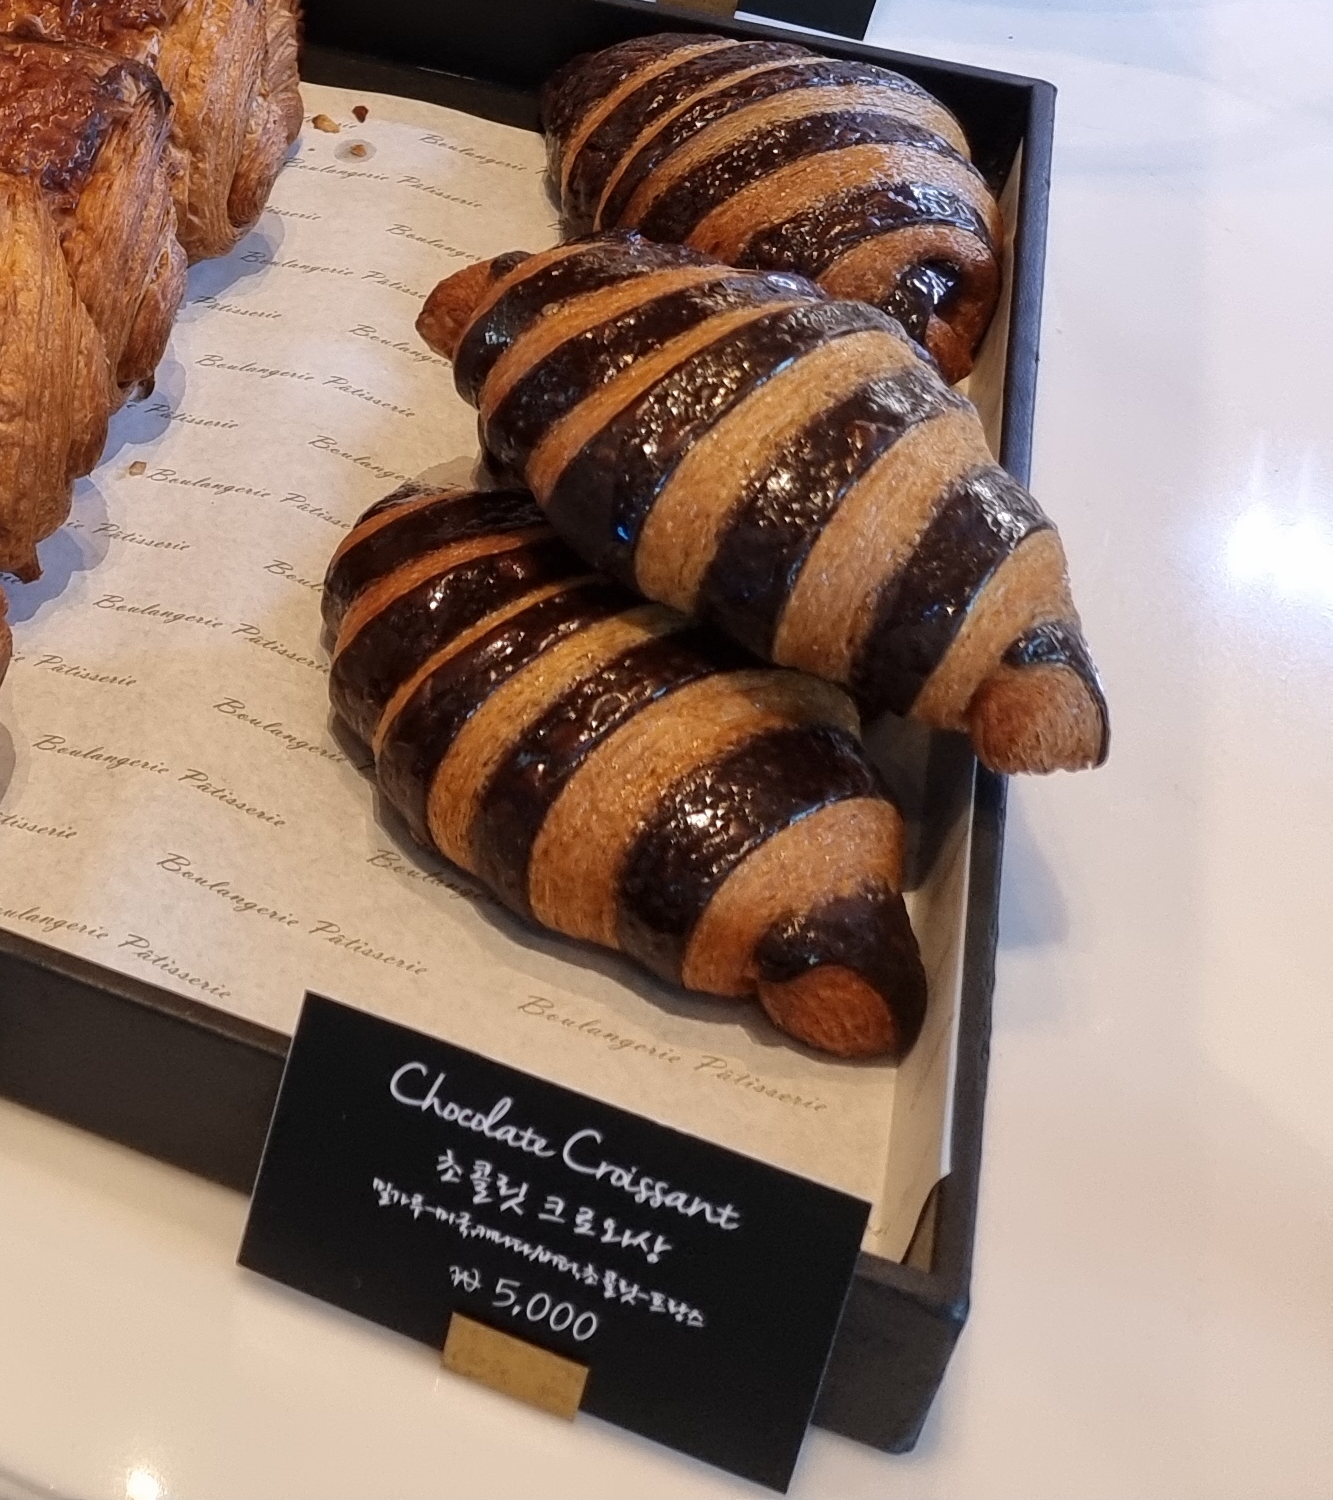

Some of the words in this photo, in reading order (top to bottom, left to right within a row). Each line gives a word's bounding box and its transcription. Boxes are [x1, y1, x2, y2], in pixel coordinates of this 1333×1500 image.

[419, 133, 527, 171] Boulangerie
[385, 223, 482, 262] Boulanger
[360, 270, 427, 300] Pâtisse
[195, 353, 315, 380] Boulangerie
[147, 468, 272, 499] Boulangerie
[280, 492, 352, 530] Pâtisse
[93, 594, 224, 631] Boulangerie
[33, 733, 170, 777] Boulangerie
[178, 768, 287, 829] Pâtisserie
[157, 852, 300, 929] Boulangerie
[309, 919, 428, 978] Pâtisserie
[118, 934, 232, 1002] Pâtisserie
[518, 994, 681, 1066] Boulangerie
[390, 1061, 556, 1158] Chocolate
[563, 1130, 740, 1230] Croissant
